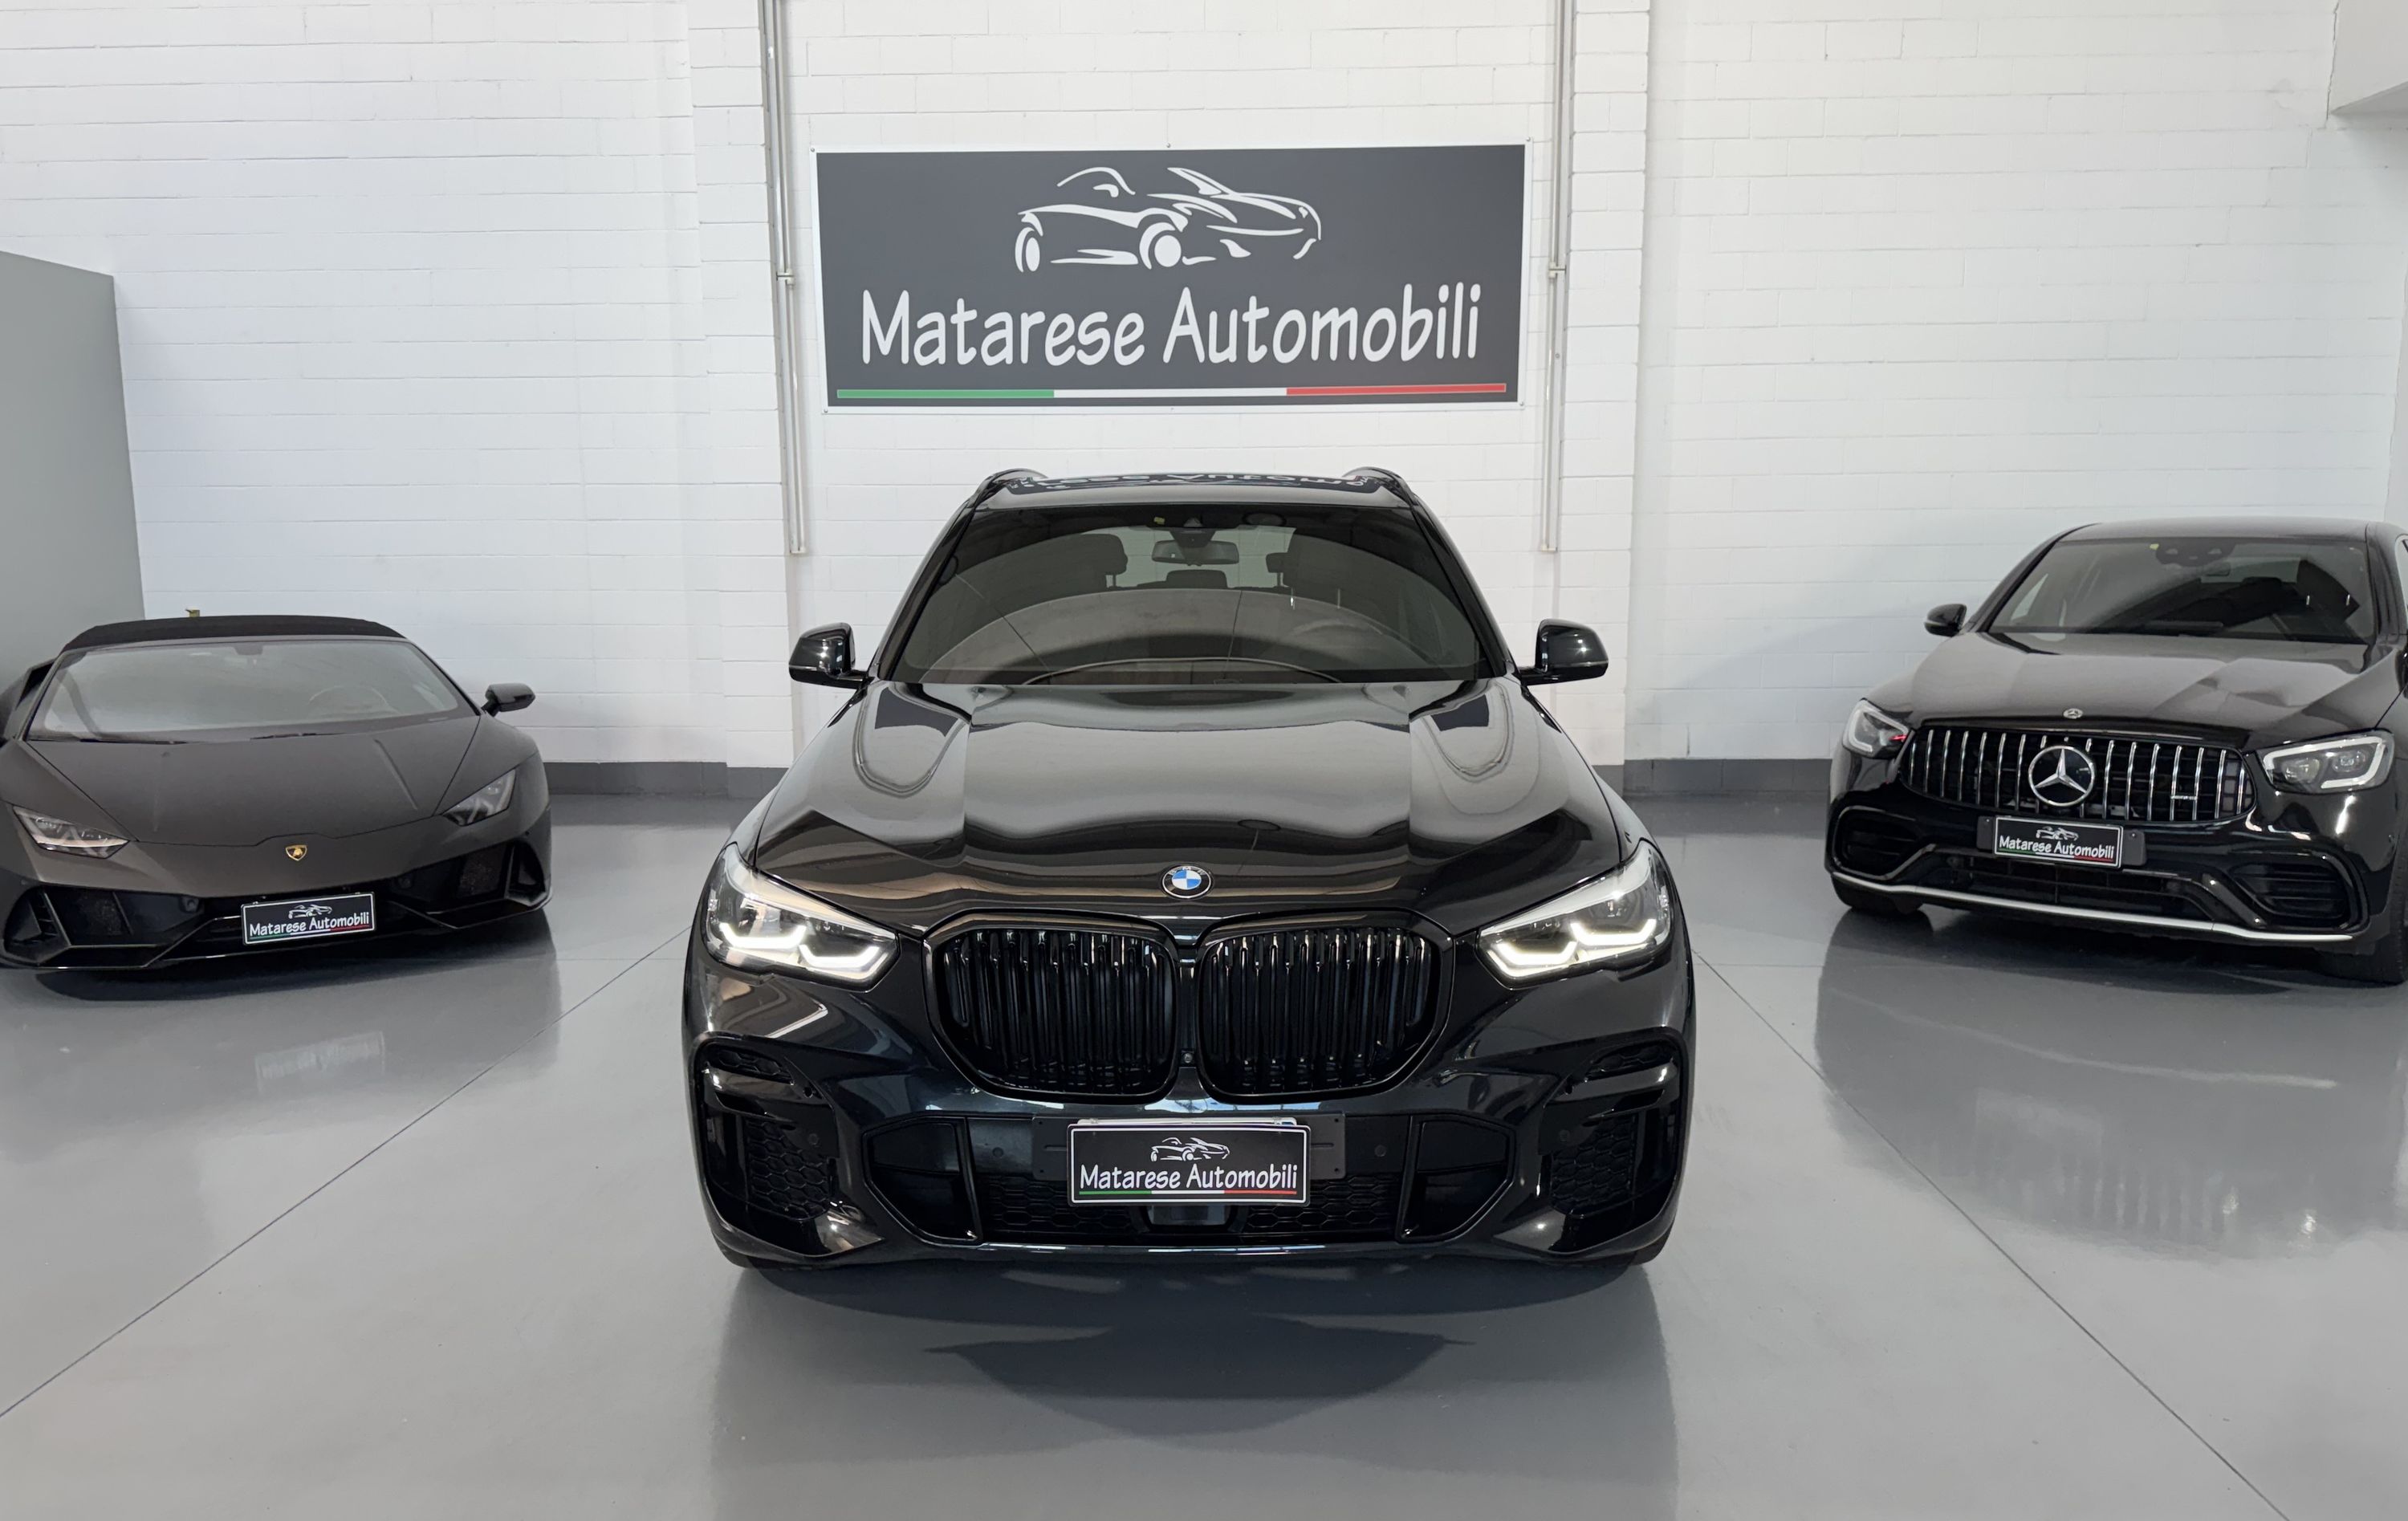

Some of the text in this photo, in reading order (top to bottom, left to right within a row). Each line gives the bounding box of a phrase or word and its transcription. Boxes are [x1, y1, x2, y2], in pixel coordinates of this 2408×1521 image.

[862, 282, 1482, 367] Matarese Automobili
[1999, 836, 2115, 859] Matarese Automobili
[250, 912, 369, 937] Matarese Automobili
[1080, 1163, 1298, 1190] Matarese Automobili
